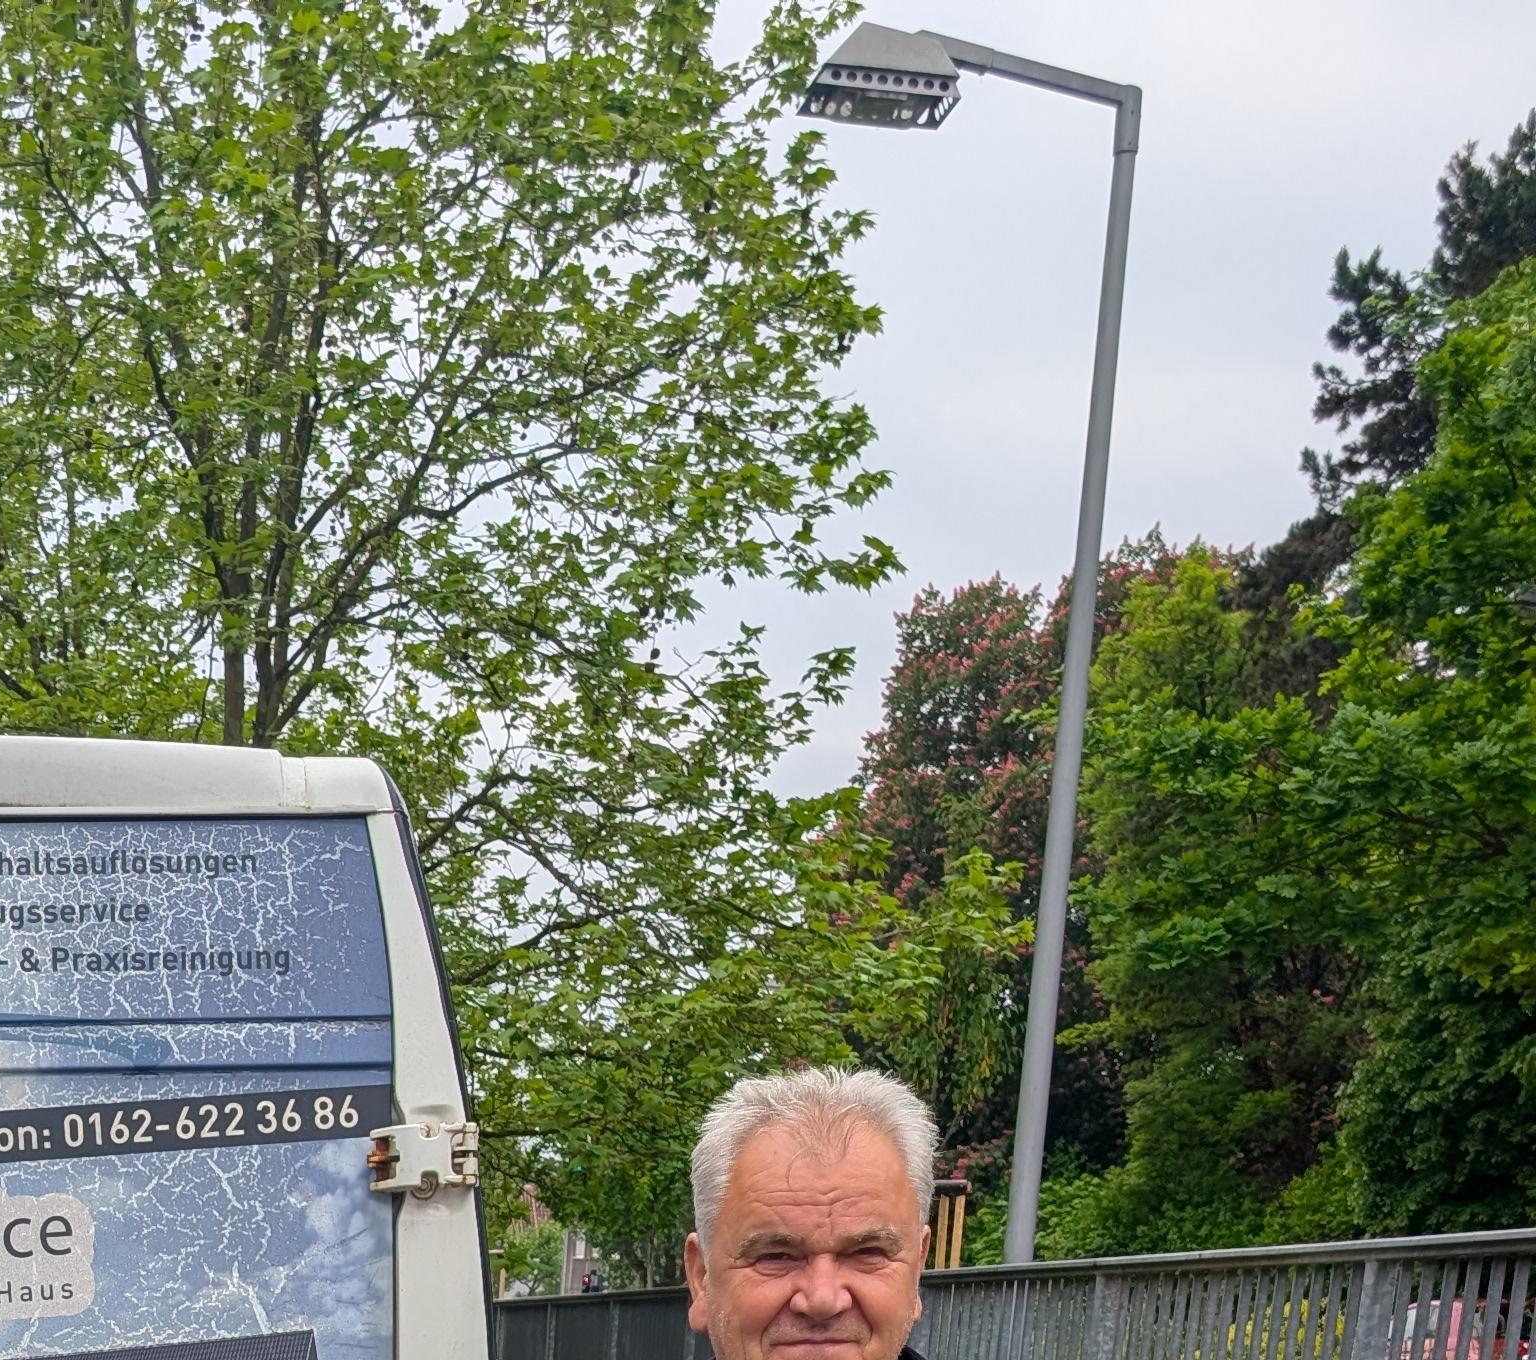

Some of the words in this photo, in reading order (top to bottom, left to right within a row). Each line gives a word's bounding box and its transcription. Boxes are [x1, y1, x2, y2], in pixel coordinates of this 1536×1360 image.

[20, 948, 42, 973] &
[51, 943, 292, 977] Praxisreinigung
[63, 1103, 245, 1147] 0162-622
[257, 1099, 301, 1134] 36
[314, 1094, 360, 1130] 86
